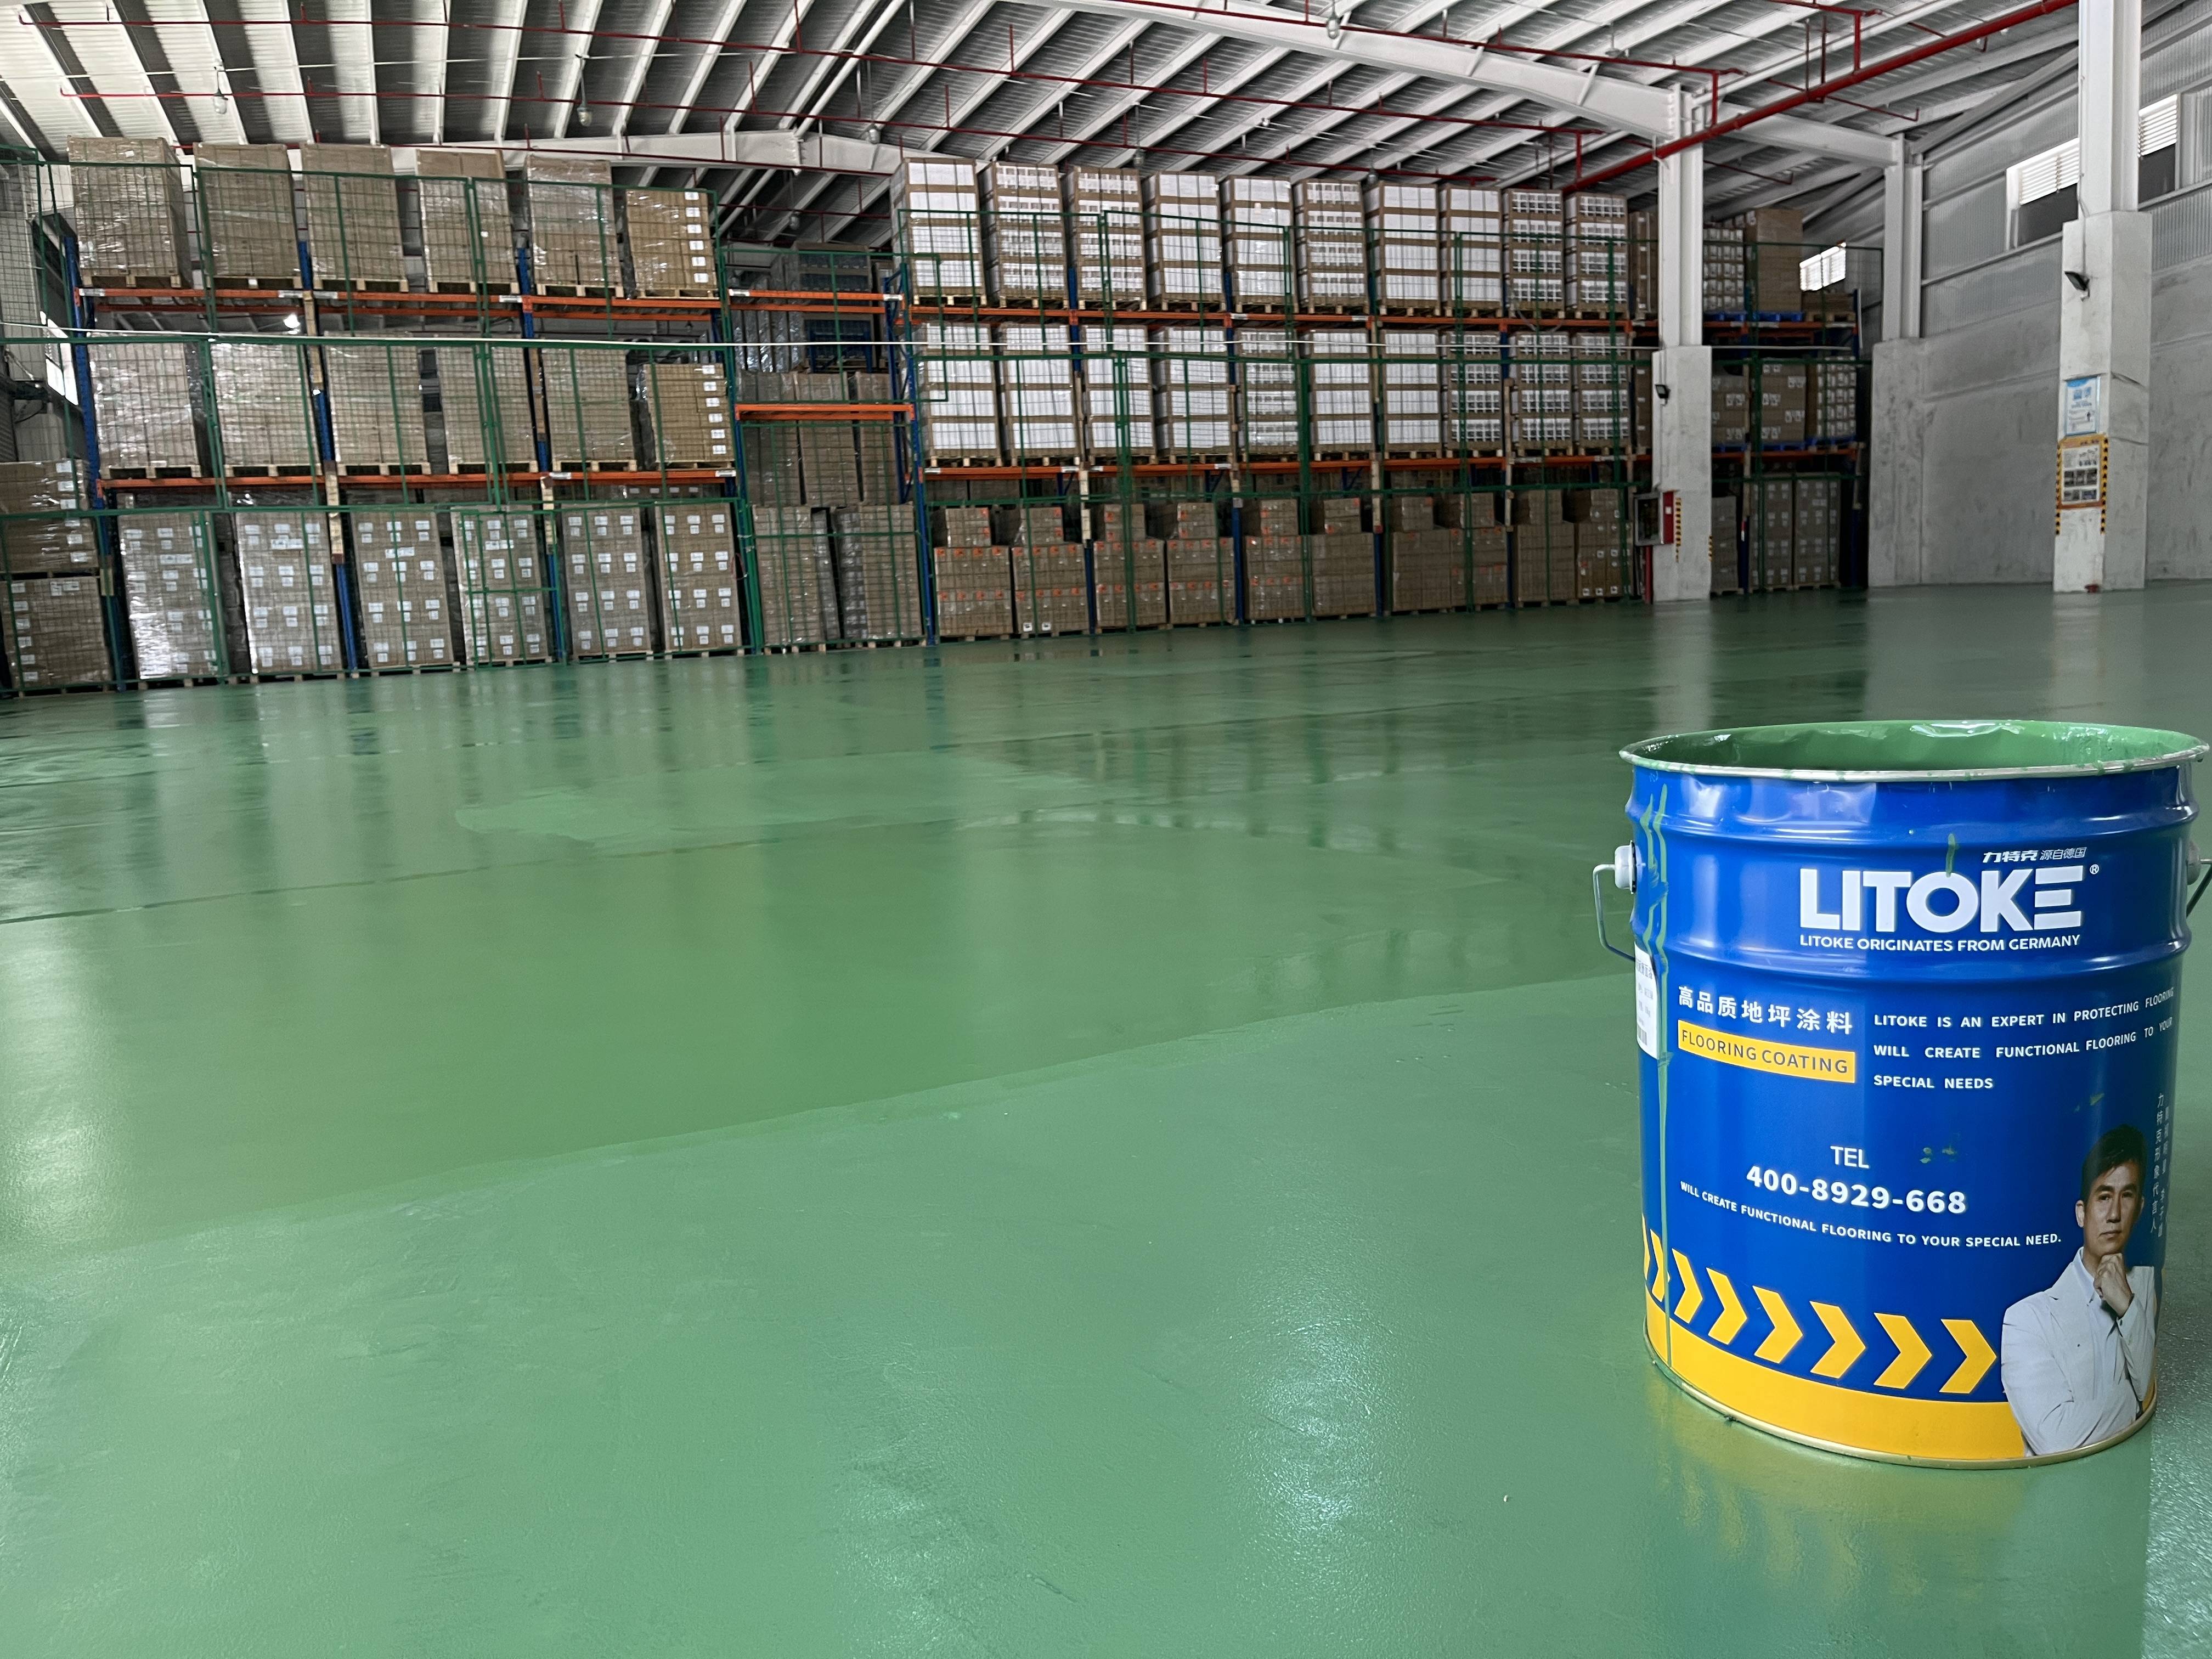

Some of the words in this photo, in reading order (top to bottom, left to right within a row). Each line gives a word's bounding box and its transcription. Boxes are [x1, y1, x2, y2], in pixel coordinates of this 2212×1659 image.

[1983, 850, 2038, 863] 力特克
[2039, 847, 2087, 861] 源自德国
[1800, 865, 2083, 933] LITOKE
[1799, 934, 1854, 950] LITOKE
[1857, 938, 1953, 952] ORIGINATES
[1957, 940, 2004, 952] FROM
[2008, 934, 2081, 950] GERMANY
[1678, 986, 1852, 1034] 高品质地坪涂料
[1874, 1014, 1927, 1027] LITOKE
[1937, 1016, 1951, 1028] IS
[1961, 1017, 1981, 1028] AN
[1991, 1014, 2044, 1028] EXPERT
[2052, 1013, 2066, 1024] IN
[2074, 1001, 2139, 1022] PROTECTING
[2145, 987, 2174, 1008] FLOORING
[1681, 1029, 1757, 1060] FLOORING
[1762, 1049, 1848, 1074] COATING
[1874, 1045, 1909, 1057] WILL
[1925, 1047, 1980, 1058] CREATE
[1996, 1041, 2080, 1058] FUNCTIONAL
[2086, 1032, 2136, 1051] FLOORING
[2144, 1026, 2153, 1038] TO
[2159, 1017, 2172, 1031] YOUR
[1874, 1074, 1935, 1088] SPECIAL
[1944, 1077, 1994, 1089] NEEDS
[1830, 1145, 1870, 1169] TEL
[1746, 1165, 1967, 1214] 400-8929-668
[1680, 1181, 1700, 1198] WILL
[1702, 1191, 1737, 1212] CREATE
[1740, 1204, 1817, 1232] FUNCTIONAL
[1821, 1223, 1891, 1243] FLOORING
[1897, 1233, 1916, 1245] TO
[1921, 1235, 1960, 1247] YOUR
[1965, 1236, 2021, 1248] SPECIAL
[2025, 1233, 2062, 1246] NEED.
